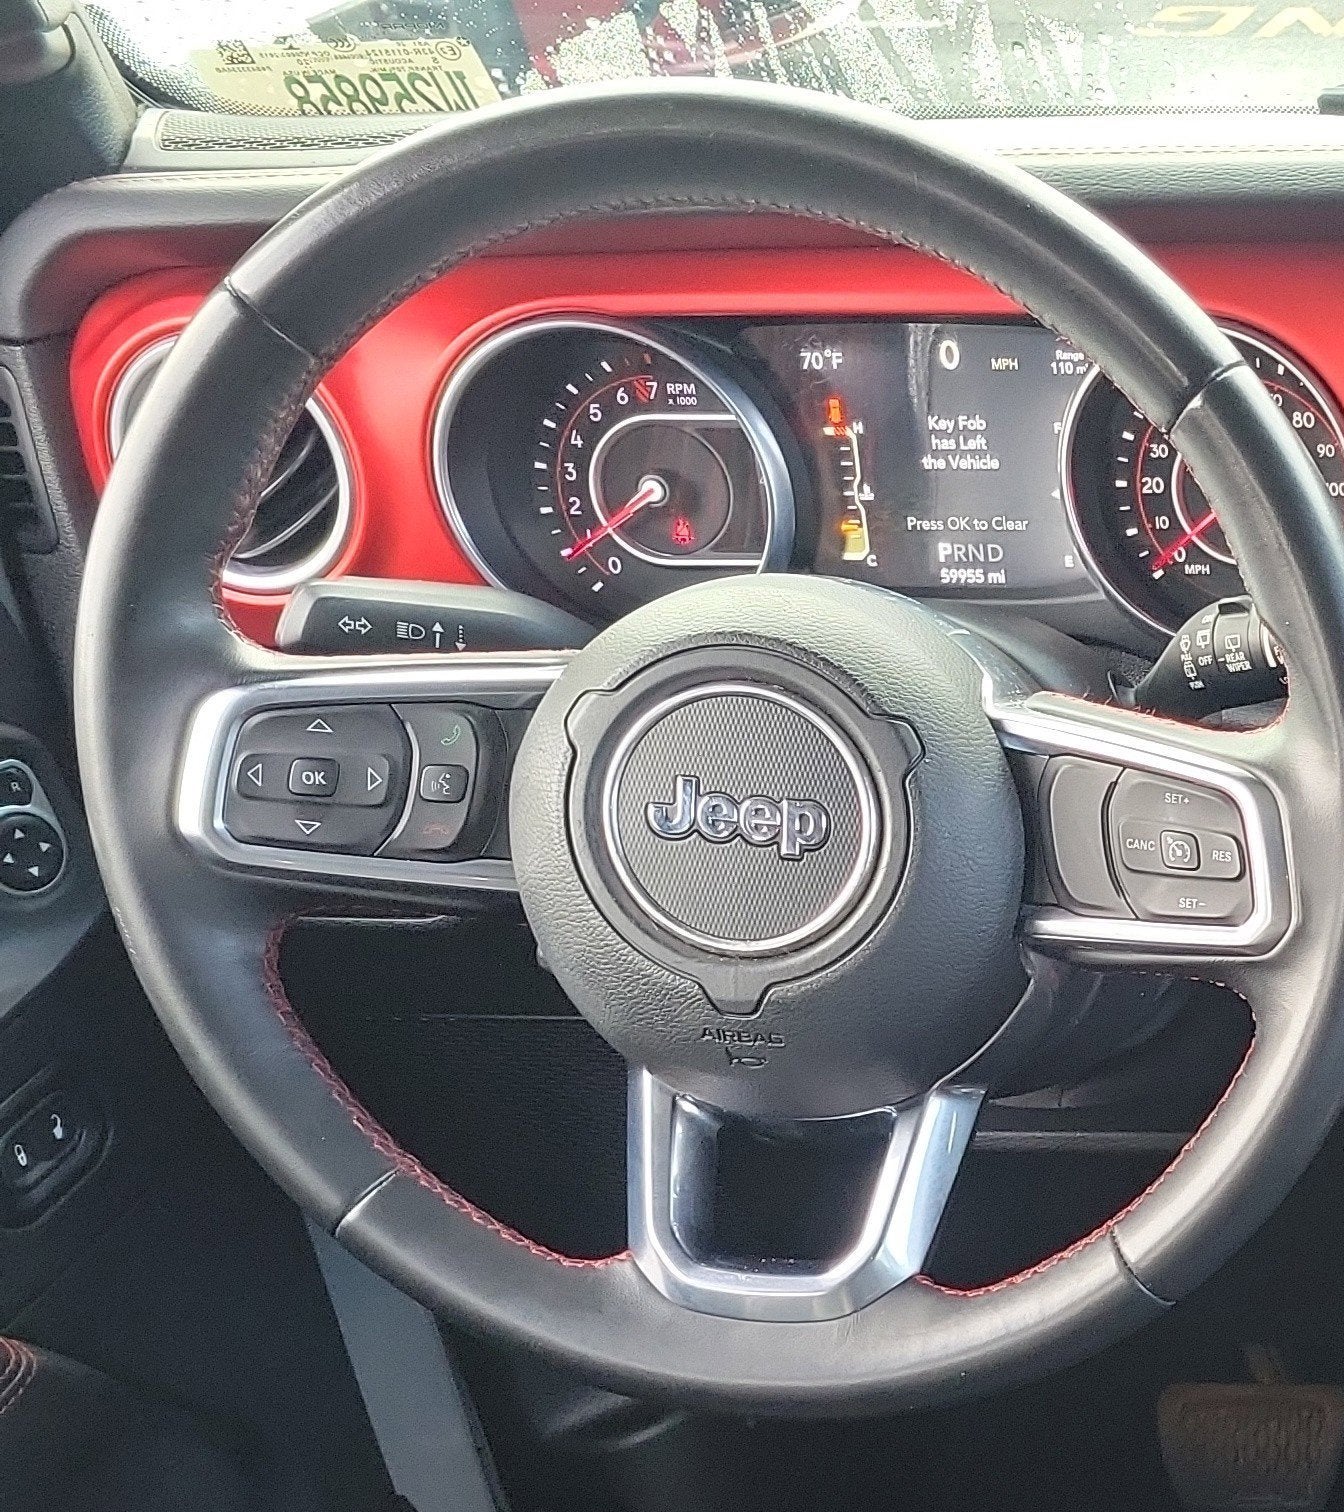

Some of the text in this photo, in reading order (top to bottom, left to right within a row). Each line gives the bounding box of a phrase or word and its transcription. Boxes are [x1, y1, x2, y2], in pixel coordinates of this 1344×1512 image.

[799, 348, 844, 371] 70°F
[939, 339, 1019, 371] 0 MPH
[1055, 350, 1085, 362] Range
[1050, 362, 1074, 375] 110
[616, 387, 629, 405] 6
[645, 381, 658, 400] 7
[666, 383, 696, 395] RPM
[589, 403, 602, 422] 5
[1292, 412, 1315, 429] 80
[852, 421, 863, 434] H
[928, 414, 986, 435] Key Fob
[571, 429, 584, 448] 4
[931, 434, 988, 451] has Left
[1150, 444, 1169, 458] 30
[1317, 444, 1335, 458] 90
[922, 454, 1000, 471] the Vehicle
[564, 463, 577, 481] 3
[1141, 477, 1165, 494] 20
[568, 496, 582, 515] 2
[906, 516, 1029, 531] Press OK to Clear
[1154, 515, 1170, 530] 10
[866, 553, 878, 567] C
[1064, 555, 1075, 568] E
[1174, 548, 1187, 563] 0
[608, 556, 622, 574] 0
[940, 558, 1006, 575] 59955 mi
[1184, 565, 1211, 576] MPH
[1198, 655, 1213, 667] OFF
[1225, 661, 1253, 673] WIPER
[301, 770, 327, 786] OK
[645, 774, 832, 862] Jeep
[1126, 838, 1156, 851] CANC
[1212, 849, 1232, 863] RES
[700, 1026, 787, 1048] AIRBAG
